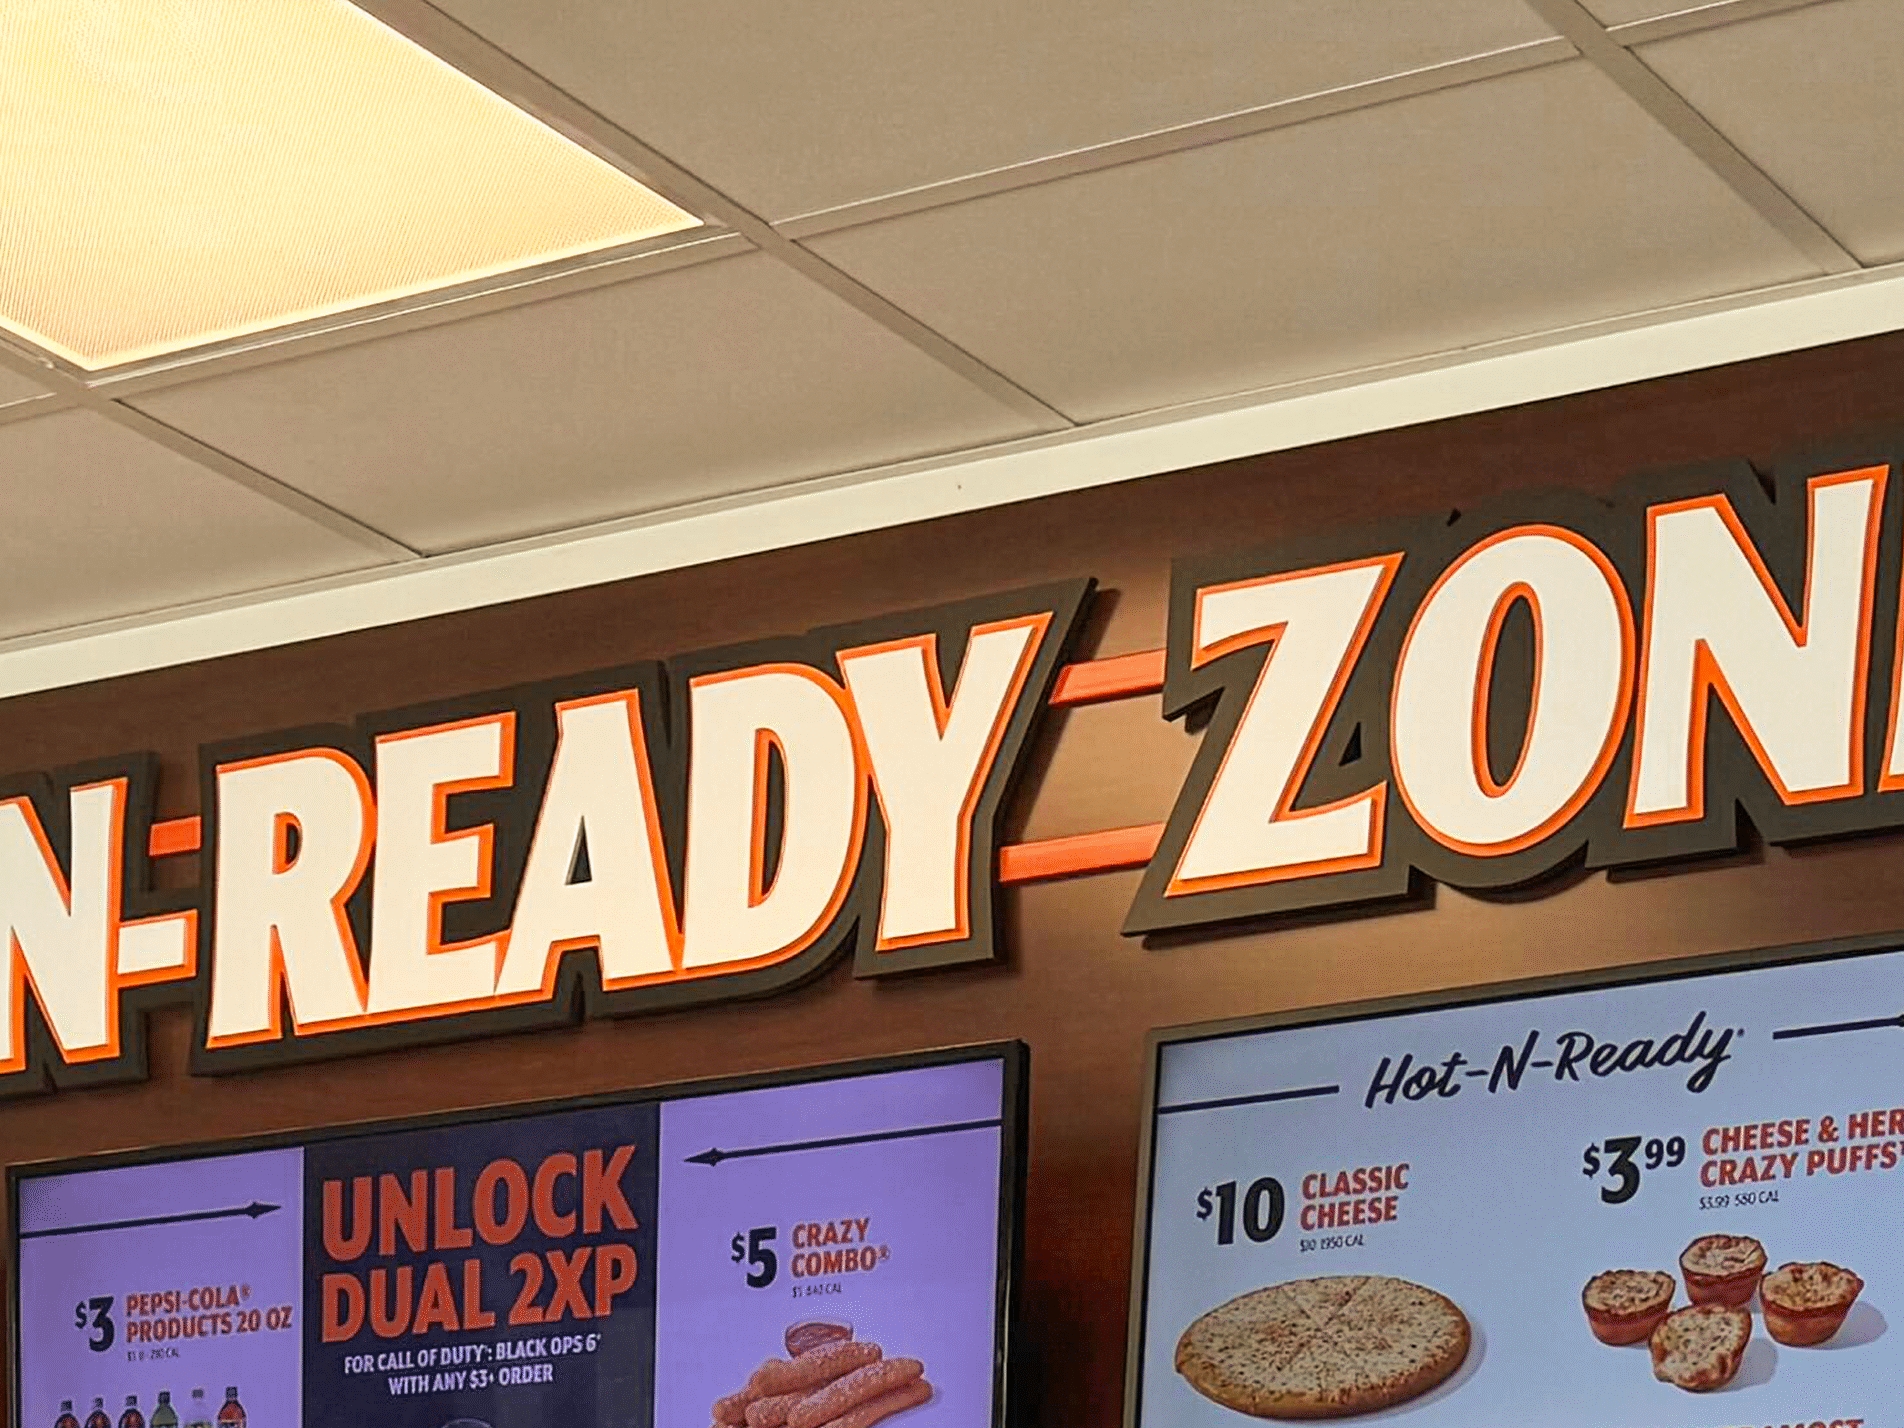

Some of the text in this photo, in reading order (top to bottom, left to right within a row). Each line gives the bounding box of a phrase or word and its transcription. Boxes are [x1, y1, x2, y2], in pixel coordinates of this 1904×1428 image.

[1363, 1009, 1737, 1109] Hot-N-Ready
[1702, 1119, 1810, 1156] CHEESE
[1817, 1116, 1840, 1143] &
[1700, 1152, 1799, 1189] CRAZY
[322, 1143, 639, 1262] UNLOCK
[1196, 1163, 1410, 1245] $10 CLASSIC
[1300, 1195, 1399, 1231] CHEESE
[1759, 1190, 1780, 1203] CAL
[731, 1217, 869, 1288] $5 CRAZY
[1345, 1234, 1364, 1247] CAL
[321, 1243, 638, 1343] DUAL 2XP
[75, 1295, 115, 1352] $3
[126, 1305, 293, 1343] PRODUCTS 20 OZ
[344, 1336, 583, 1374] FOR CALL OF BLACK OPS
[388, 1376, 429, 1396] WITH
[433, 1373, 467, 1392] ANY
[498, 1364, 553, 1387] ORDER
